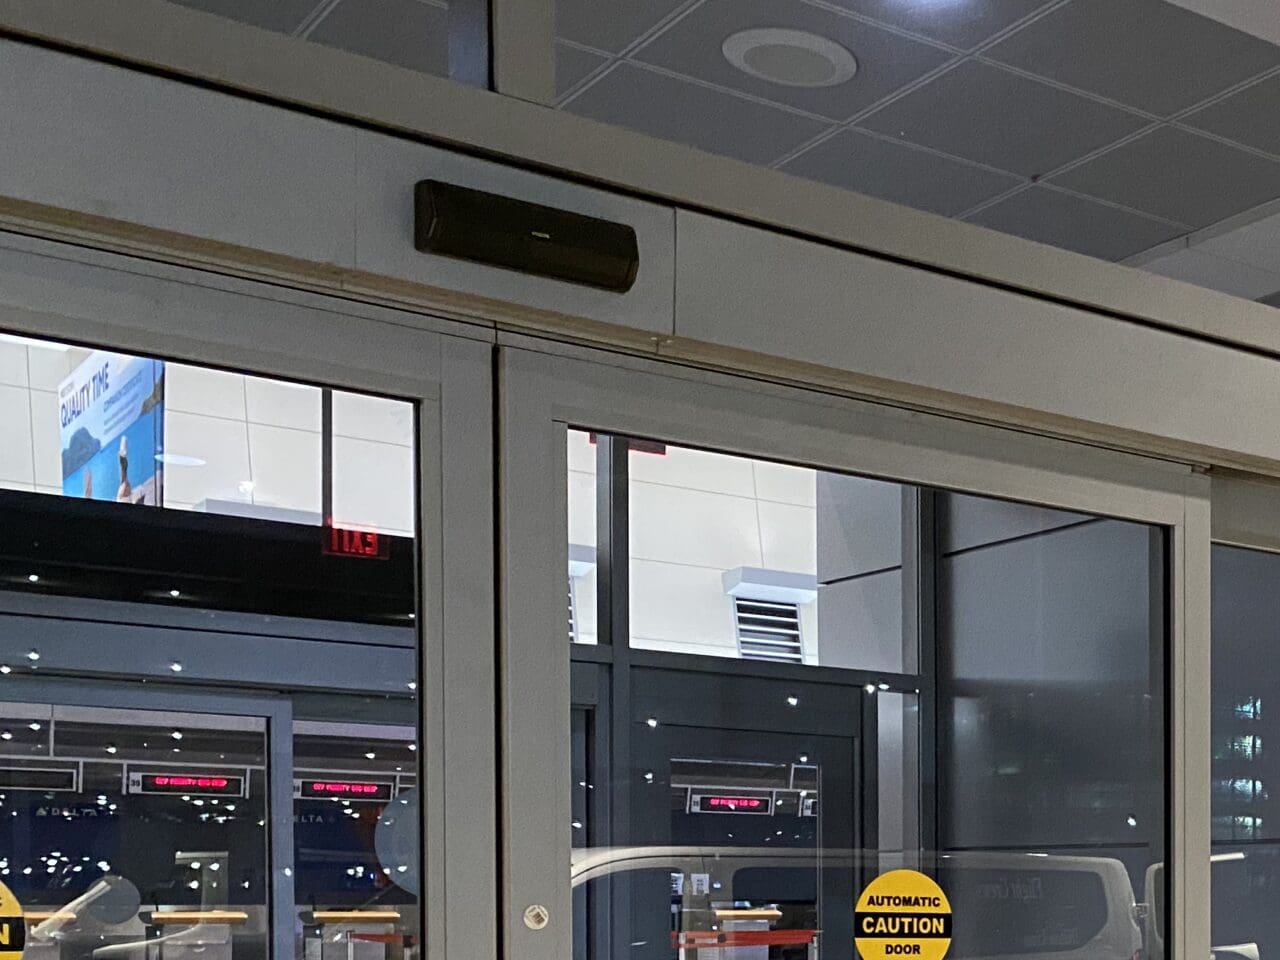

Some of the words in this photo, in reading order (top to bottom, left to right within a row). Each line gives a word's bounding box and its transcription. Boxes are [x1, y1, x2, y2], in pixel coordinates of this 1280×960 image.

[61, 377, 90, 428] QUALITY
[92, 361, 109, 402] TIME
[867, 895, 941, 907] AUTOMATIC
[862, 917, 945, 934] CAUTION
[885, 944, 921, 955] DOOR
